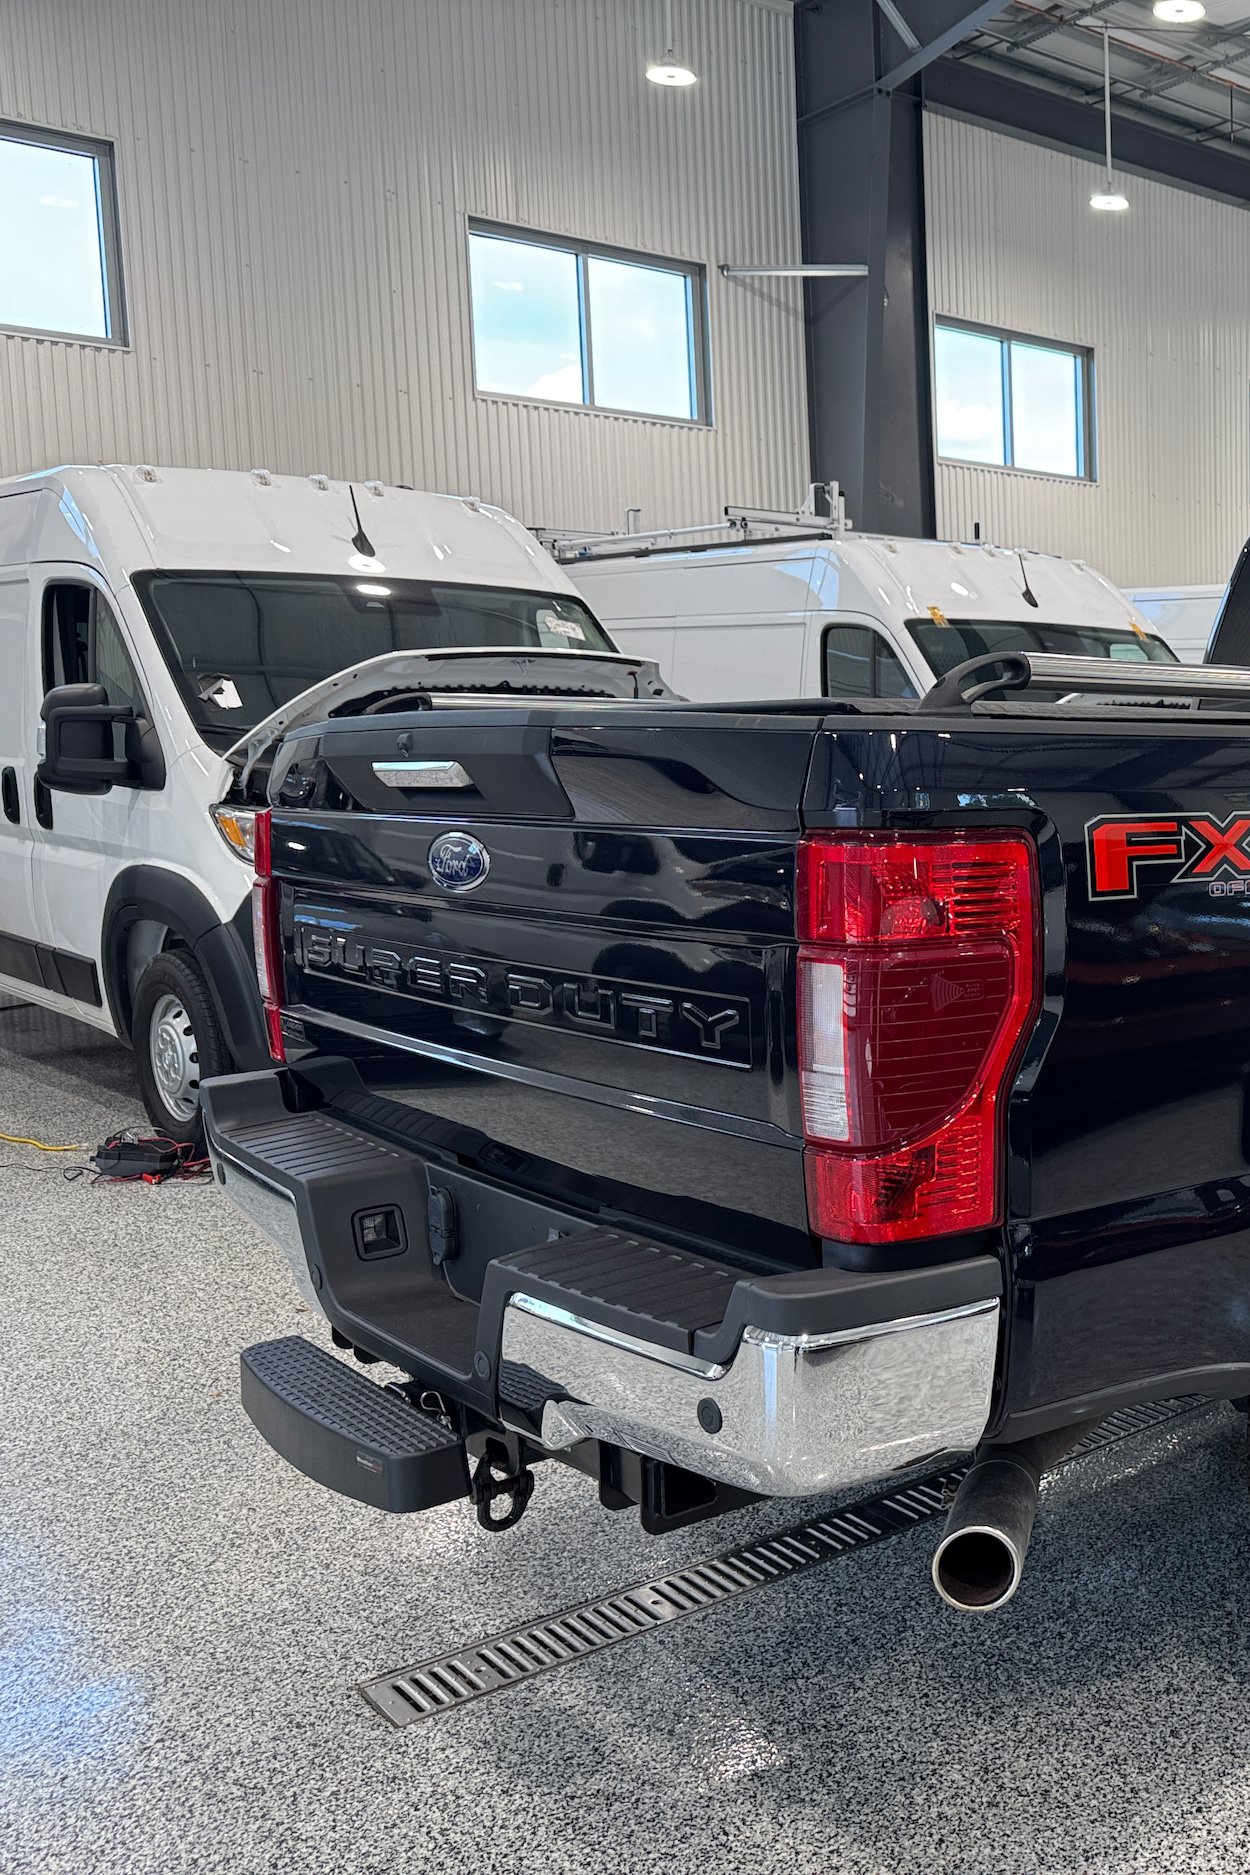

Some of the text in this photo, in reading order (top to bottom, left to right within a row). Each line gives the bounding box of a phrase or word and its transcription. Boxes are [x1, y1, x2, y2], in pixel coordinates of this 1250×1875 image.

[435, 844, 480, 876] Ford
[307, 932, 740, 1049] SUPER DUTY
